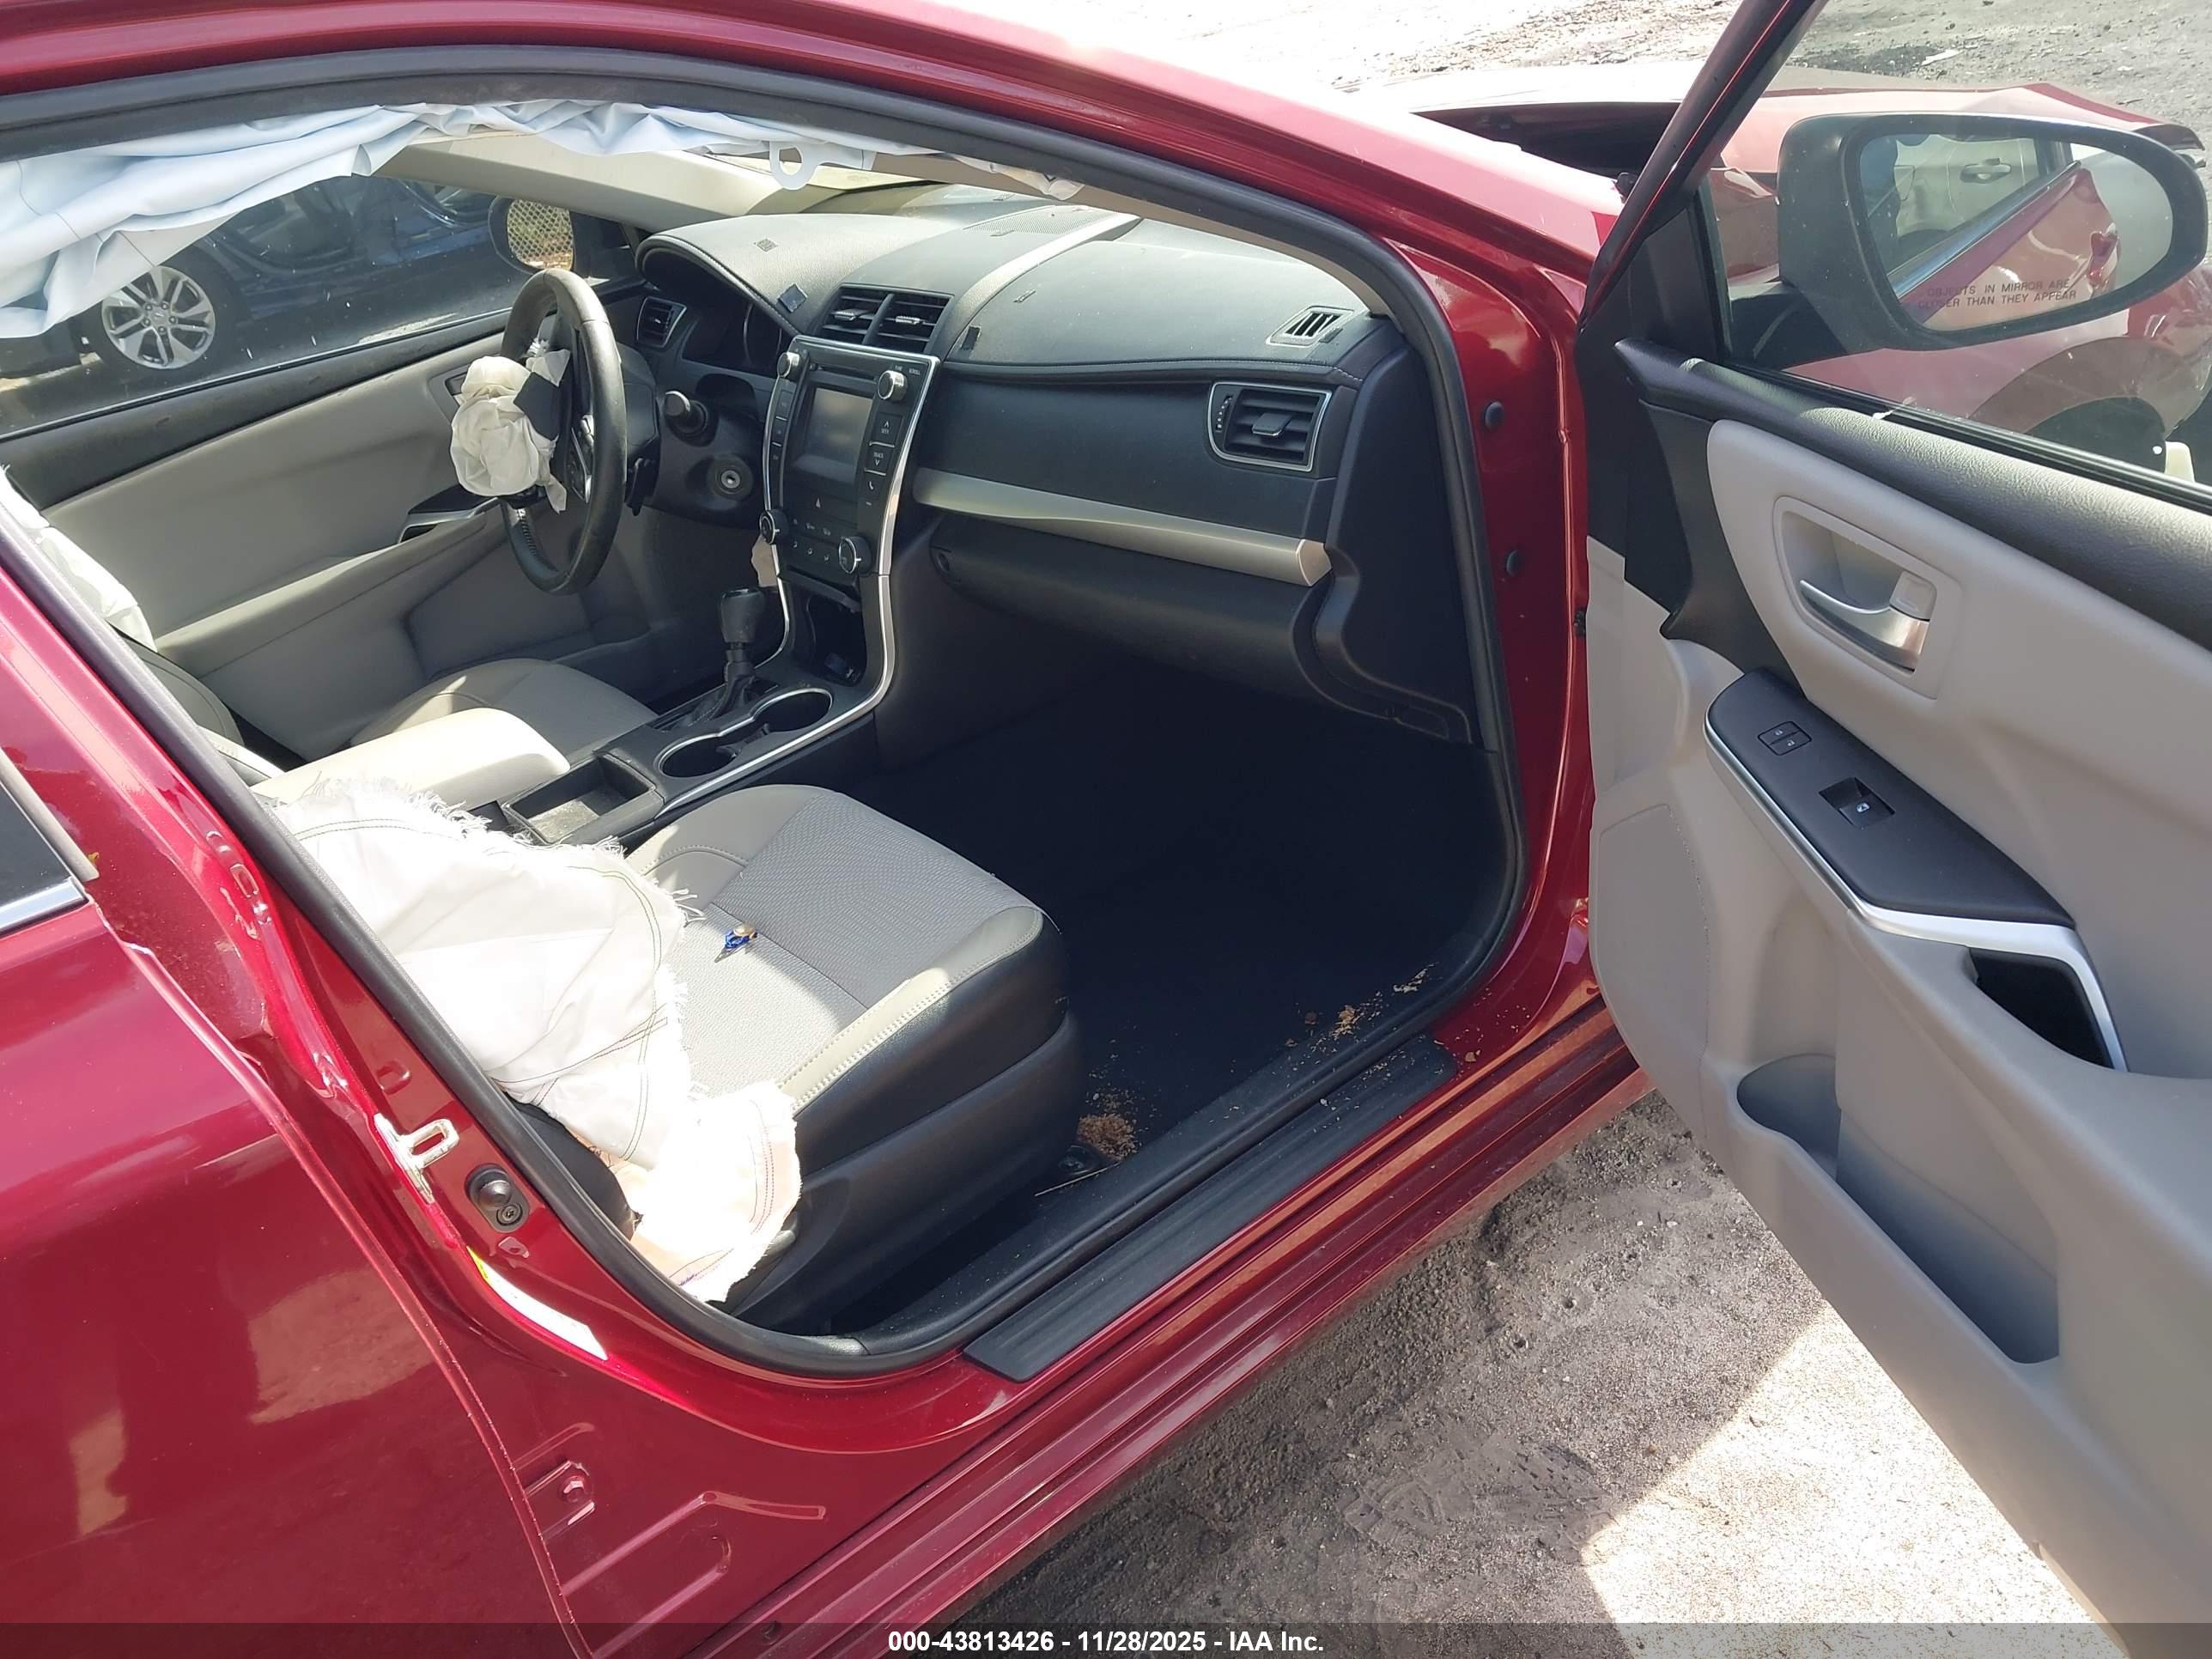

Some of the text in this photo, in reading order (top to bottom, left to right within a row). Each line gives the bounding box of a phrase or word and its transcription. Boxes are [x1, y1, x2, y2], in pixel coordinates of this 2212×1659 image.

[1984, 283, 1996, 294] IN
[2001, 281, 2043, 293] MIRROR
[2048, 278, 2070, 289] ARE
[1966, 295, 1995, 307] THAN
[2002, 293, 2029, 304] THEY
[2033, 290, 2076, 301] APPEAR
